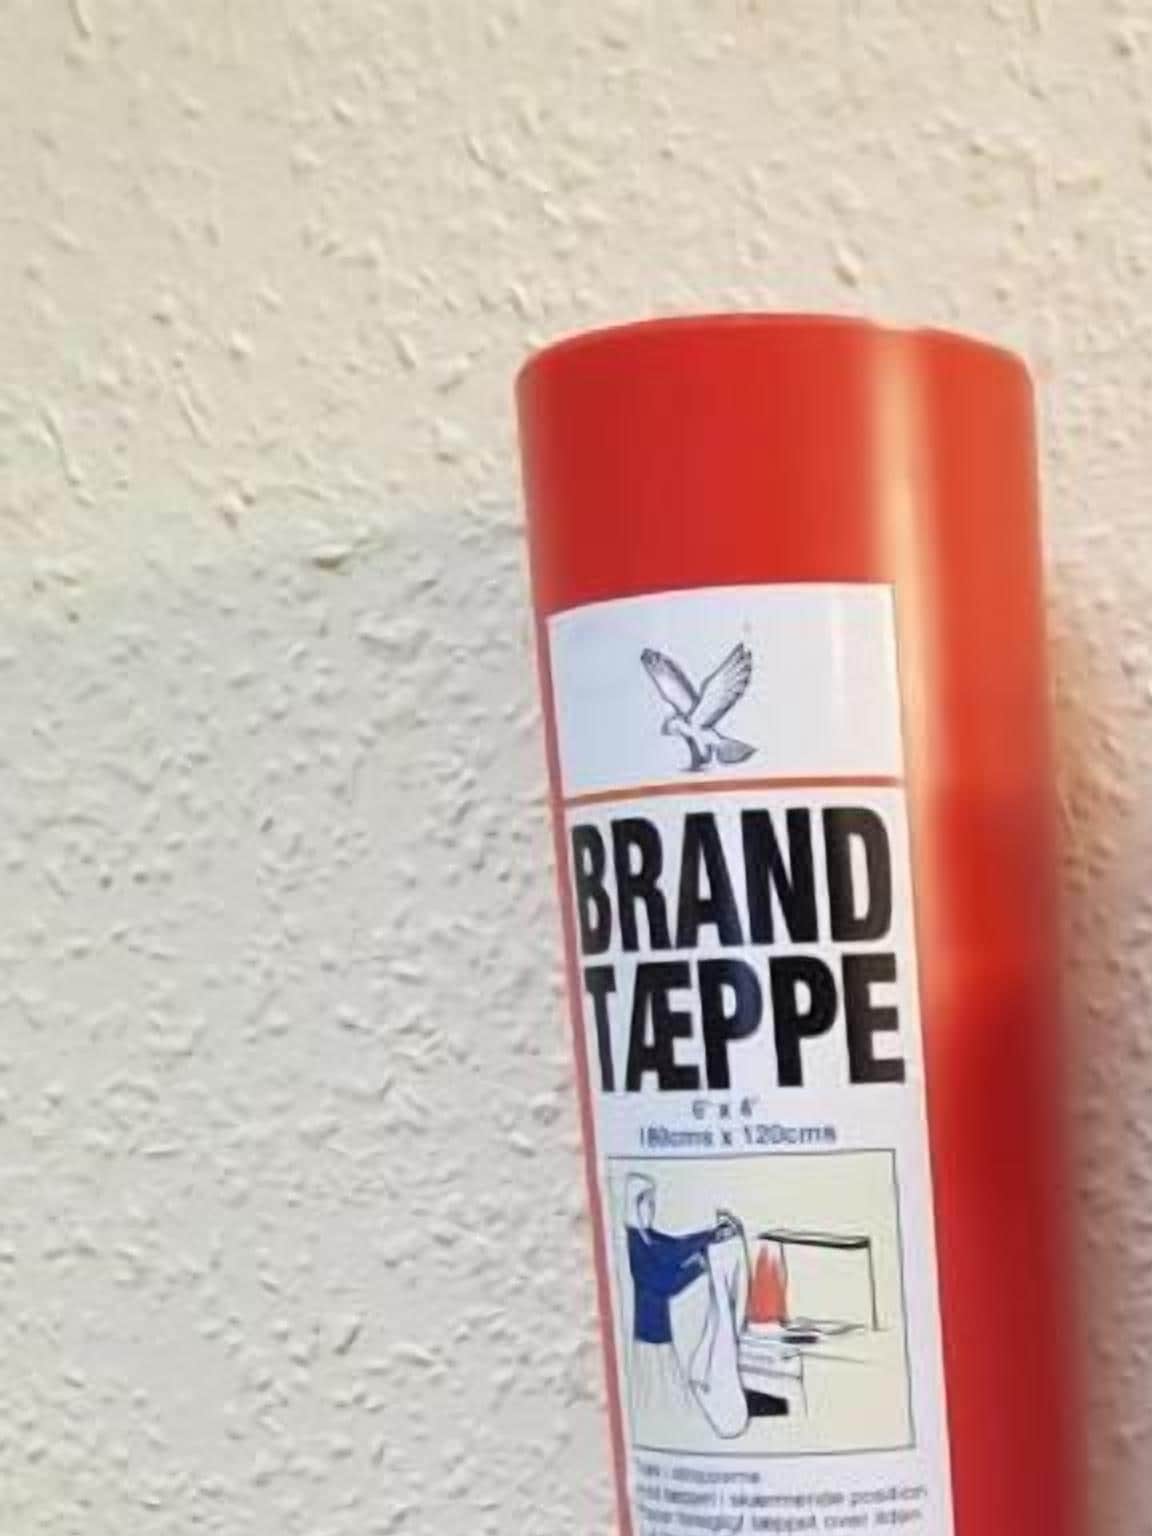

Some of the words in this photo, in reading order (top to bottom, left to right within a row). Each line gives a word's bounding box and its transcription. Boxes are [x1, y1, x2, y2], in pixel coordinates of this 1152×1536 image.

[571, 807, 893, 956] BRAND
[584, 952, 906, 1093] TÆPPE
[744, 1123, 837, 1145] 120cms
